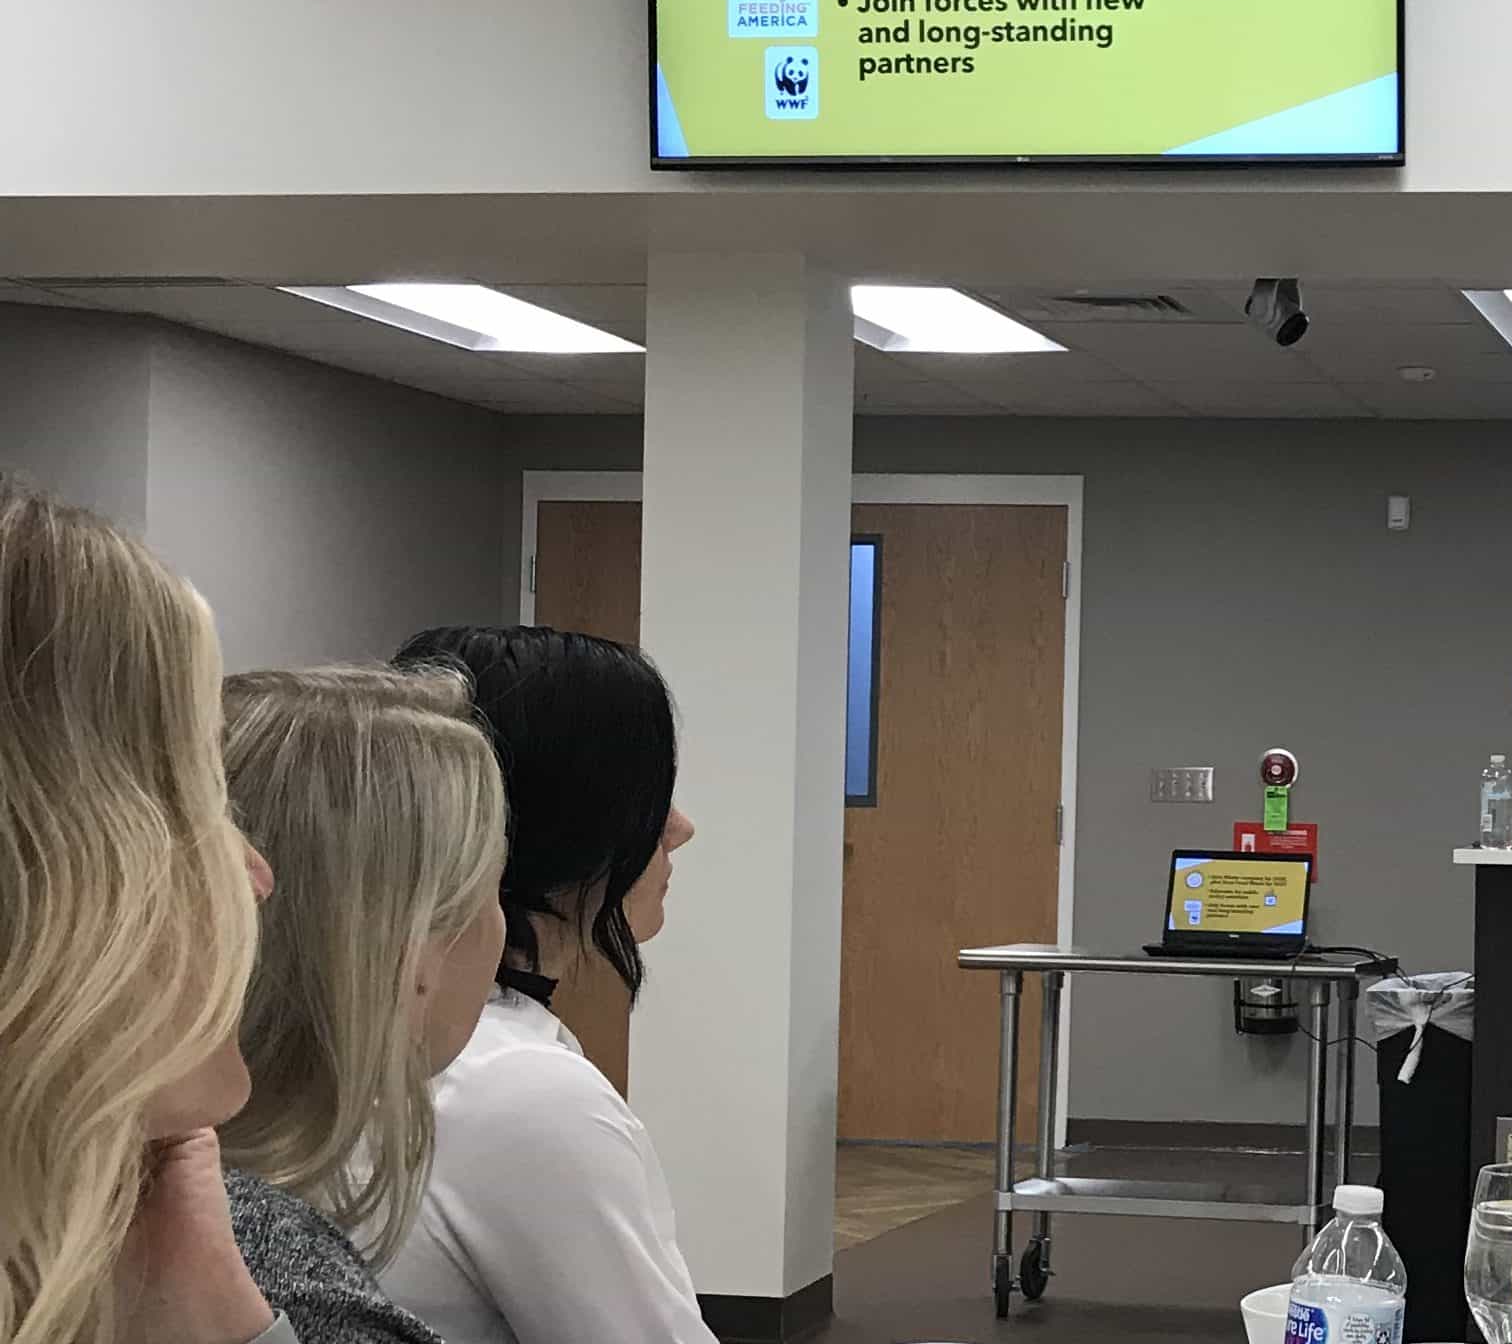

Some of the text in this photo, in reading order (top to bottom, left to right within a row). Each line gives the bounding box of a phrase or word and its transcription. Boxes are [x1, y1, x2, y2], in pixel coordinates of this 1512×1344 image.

[738, 2, 807, 14] FEEDING
[737, 15, 808, 28] AMERICA
[858, 18, 1113, 49] and long-standing
[859, 54, 975, 81] partners
[775, 99, 808, 110] WWF
